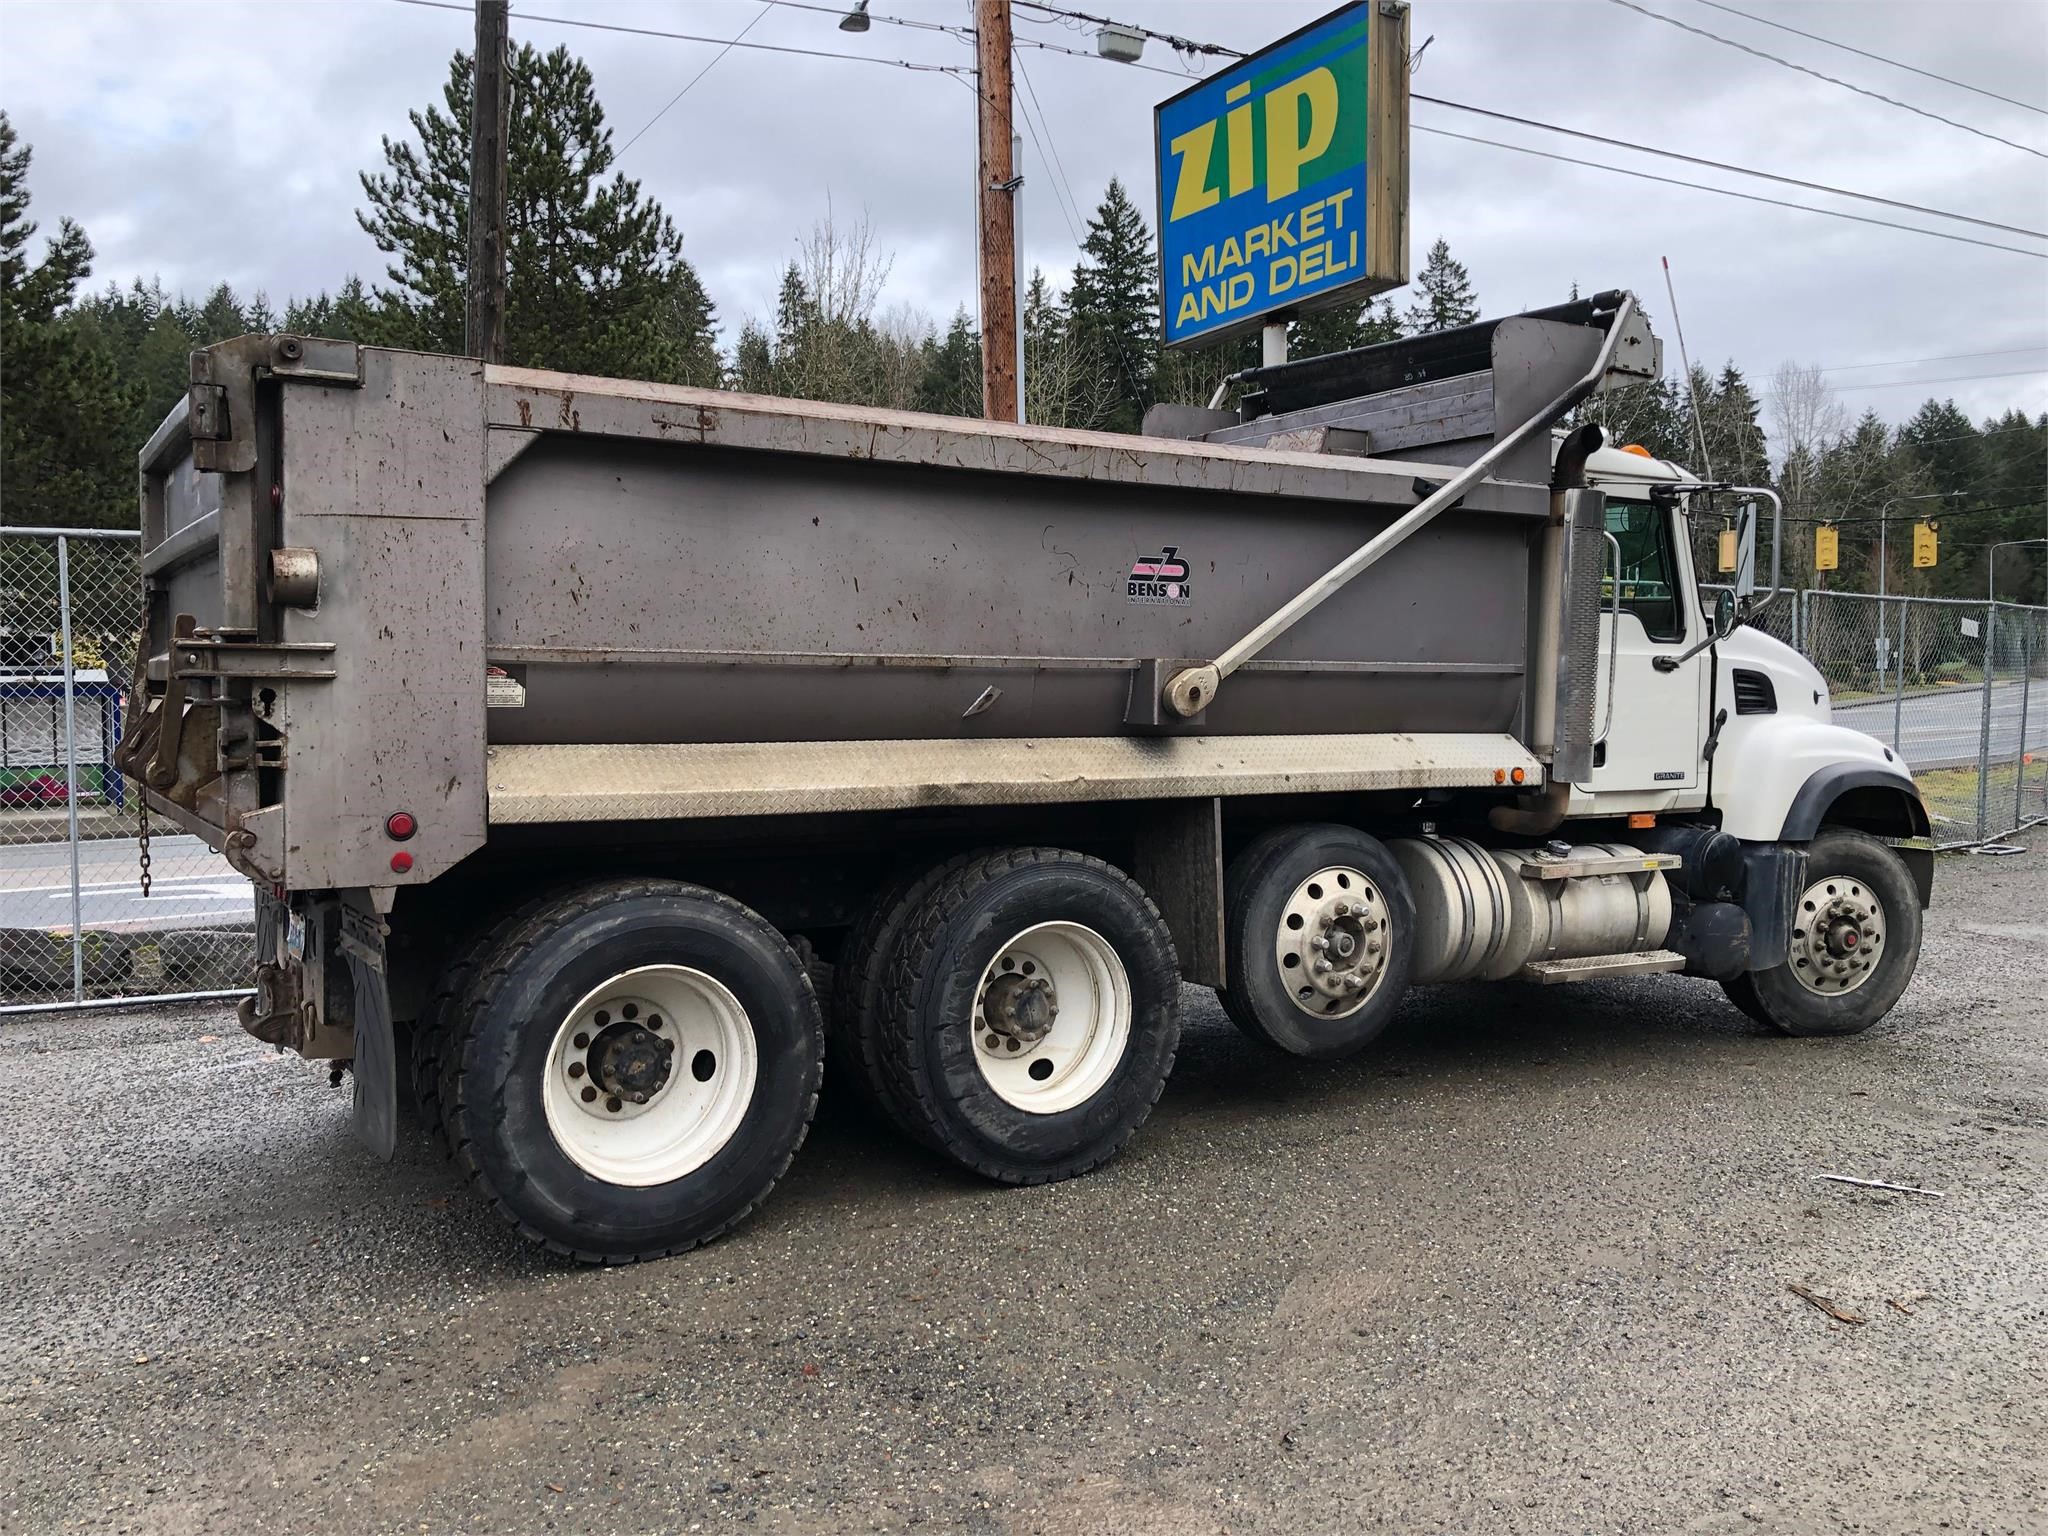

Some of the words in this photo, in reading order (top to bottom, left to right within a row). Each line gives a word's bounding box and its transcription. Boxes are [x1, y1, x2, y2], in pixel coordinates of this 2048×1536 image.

[1182, 188, 1353, 287] MARKET
[1175, 274, 1255, 329] AND
[1269, 231, 1358, 297] DELI
[1127, 583, 1190, 598] BENSON
[1127, 597, 1191, 606] INTERNATIONAL
[1655, 772, 1685, 780] GRANITE
